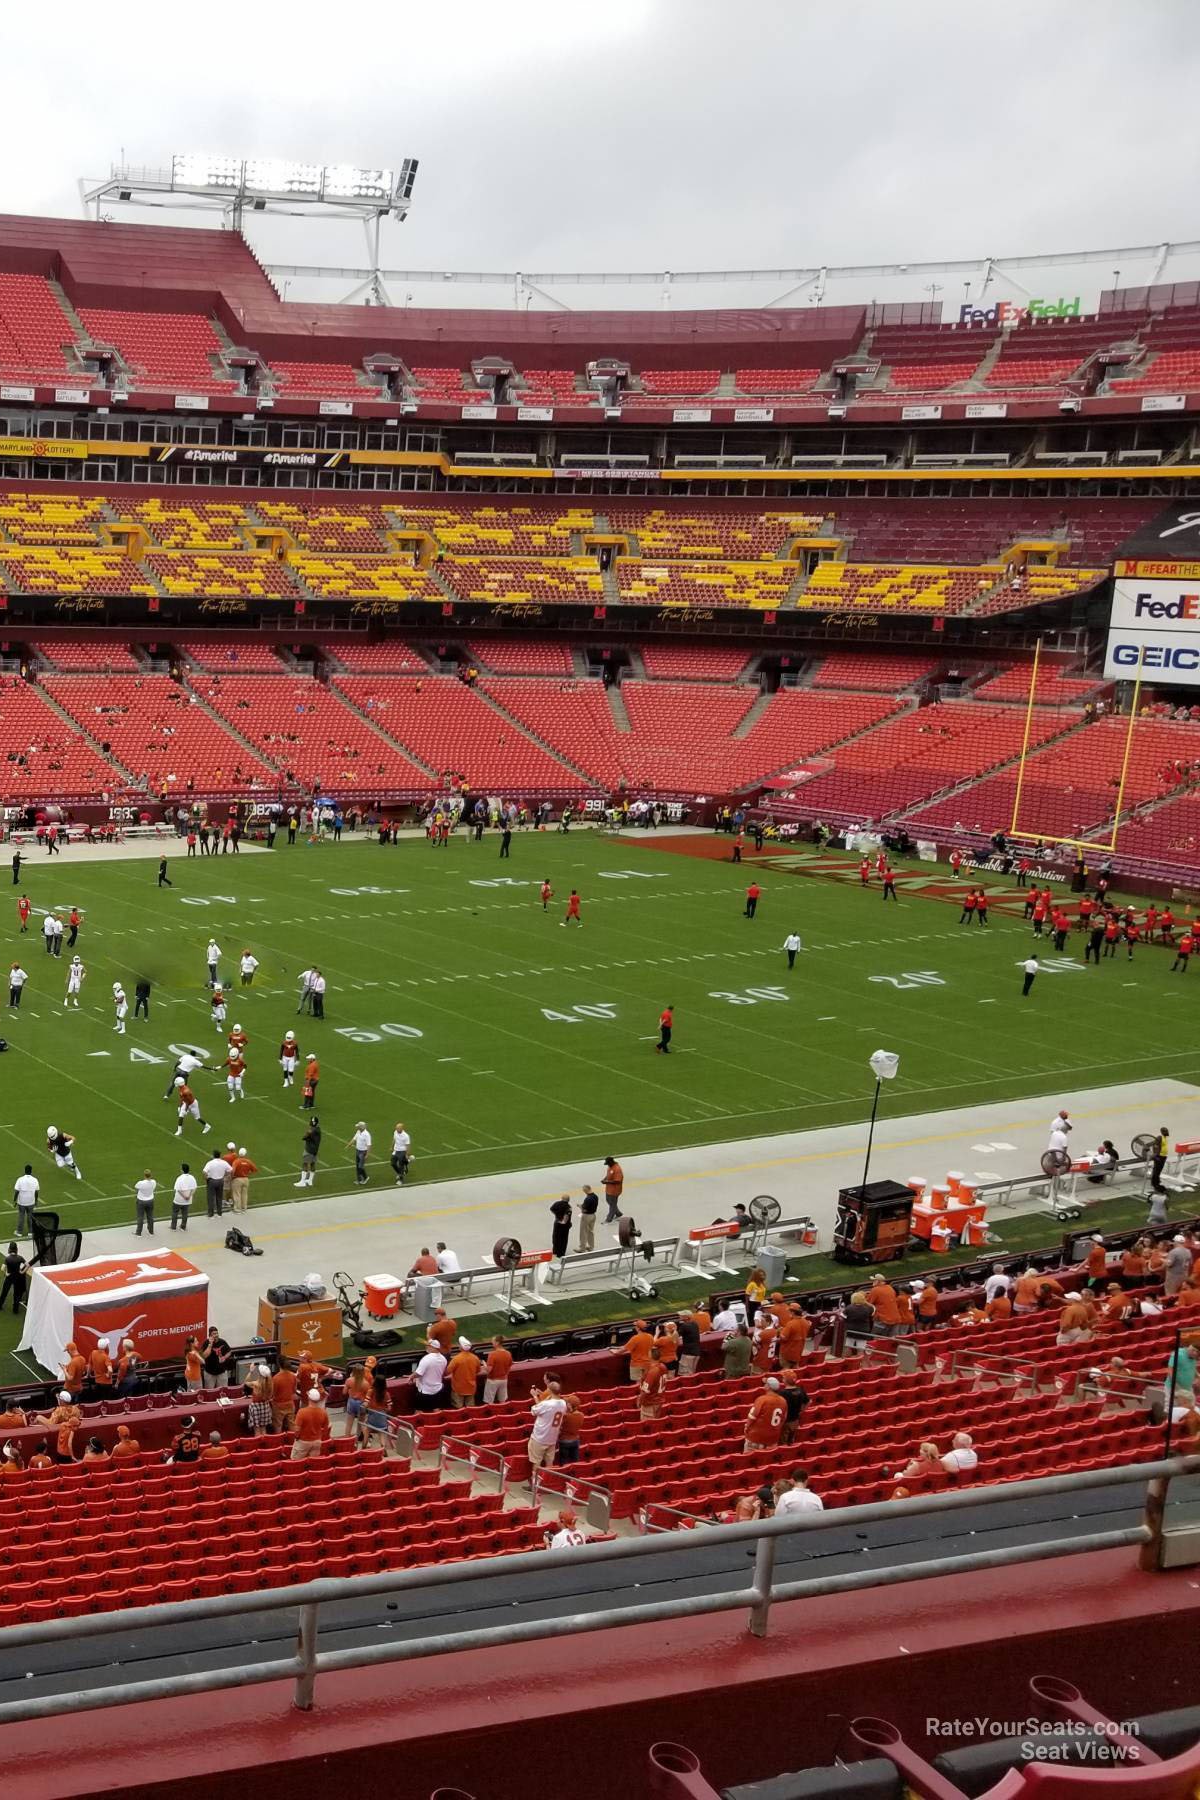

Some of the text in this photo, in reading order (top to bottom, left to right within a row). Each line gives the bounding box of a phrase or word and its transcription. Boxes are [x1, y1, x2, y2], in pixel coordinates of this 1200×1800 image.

[47, 446, 75, 454] LOTTERY
[1125, 561, 1137, 575] M
[334, 1023, 424, 1043] 50
[137, 1322, 206, 1339] SPORTS MEDICINE
[551, 1412, 562, 1428] 8
[771, 1408, 782, 1427] 6
[182, 1438, 198, 1451] 28
